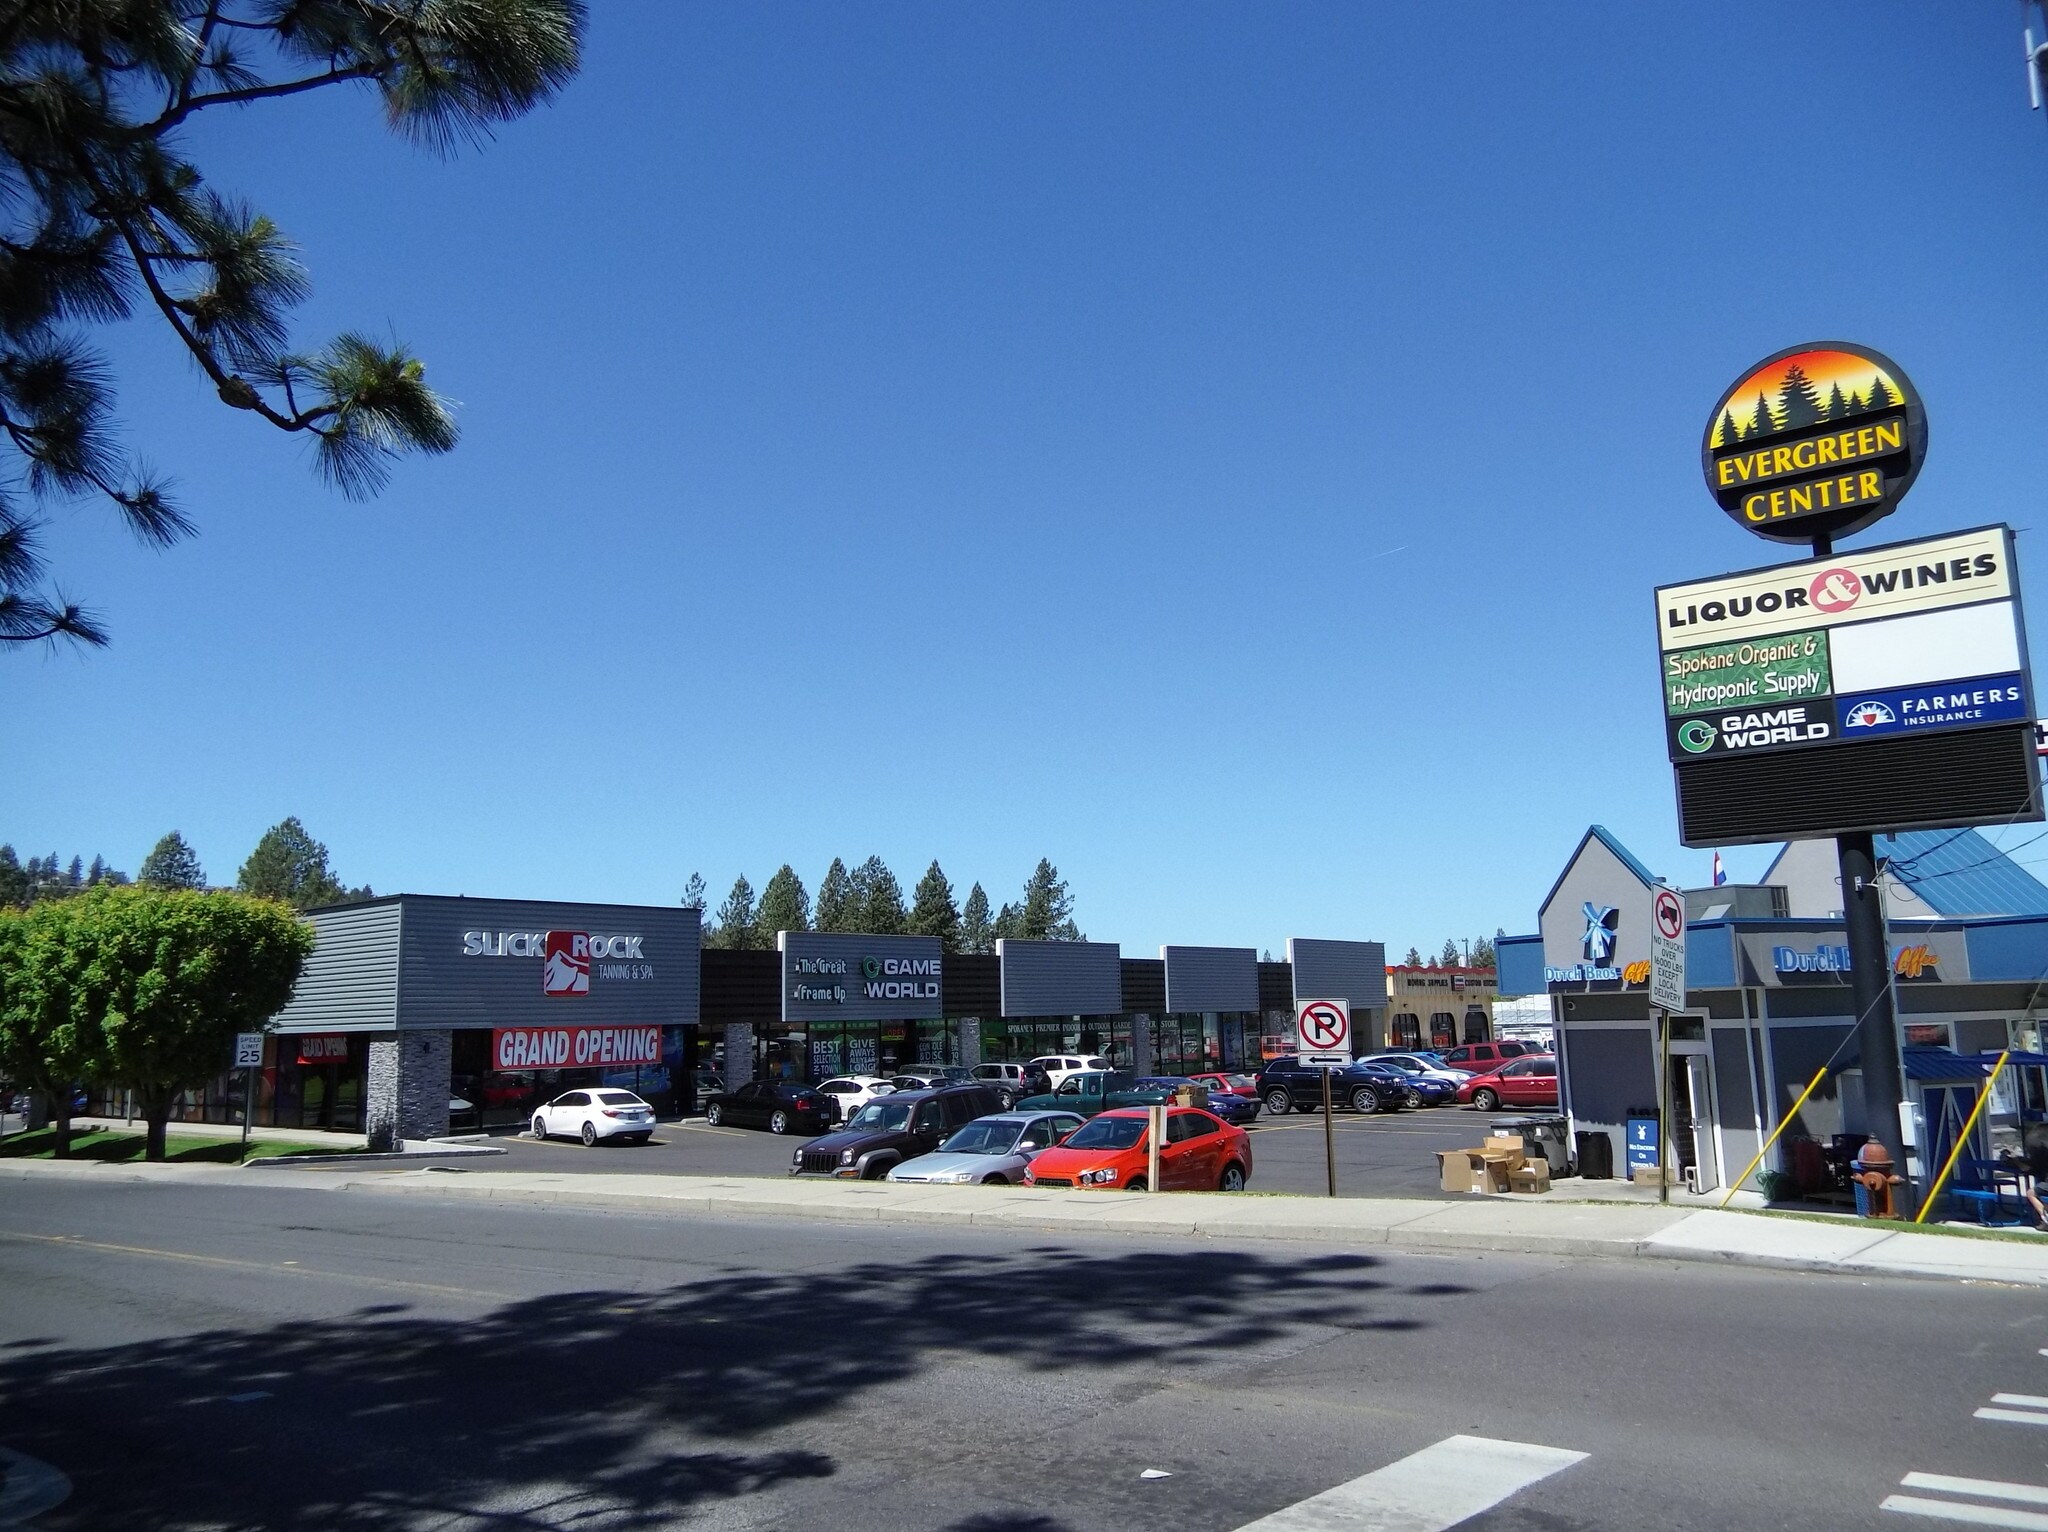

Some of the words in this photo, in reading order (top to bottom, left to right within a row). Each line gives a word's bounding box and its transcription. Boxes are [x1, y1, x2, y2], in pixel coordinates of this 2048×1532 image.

[1718, 422, 1901, 486] EVERGREEN
[1745, 472, 1880, 522] CENTER
[1668, 587, 1808, 628] LIQUOR
[1816, 572, 1860, 607] &
[1861, 553, 1996, 595] WINES
[1668, 652, 1734, 679] Spokane
[1738, 641, 1799, 668] Organic
[1804, 636, 1817, 656] &
[1672, 678, 1759, 709] Hydroponic
[1764, 668, 1820, 696] Supply
[1901, 686, 2019, 714] FARMERS
[1722, 707, 1807, 732] GAME
[1904, 709, 1982, 726] INSURANCE
[1722, 723, 1829, 749] WORLD
[463, 931, 546, 957] SLICK
[572, 934, 644, 959] ROCK
[1653, 935, 1661, 946] NO
[1663, 938, 1684, 954] TRUCKS
[1661, 948, 1677, 960] OVER
[1894, 944, 1938, 978] Coffee
[598, 964, 630, 979] TANNING
[632, 965, 638, 979] &
[640, 965, 653, 979] SPA
[800, 958, 816, 974] The
[818, 958, 847, 974] Great
[884, 959, 941, 975] GAME
[1623, 960, 1650, 984] Coff
[1657, 967, 1679, 979] EXCEPT
[1672, 963, 1683, 974] LBS
[800, 984, 832, 1000] Frame
[834, 985, 846, 1003] Up
[866, 982, 938, 998] WORLD
[1658, 979, 1678, 992] LOCAL
[1654, 986, 1681, 1004] DELIVERY
[1036, 1023, 1060, 1032] PREMIER
[1063, 1023, 1081, 1032] INDOOR
[1088, 1022, 1110, 1031] OUTDOOR
[1113, 1021, 1132, 1029] GARDE
[1161, 1020, 1178, 1028] STORE
[500, 1030, 570, 1067] GRAND
[575, 1028, 658, 1063] OPENING
[813, 1041, 840, 1054] BEST
[850, 1039, 875, 1049] GIVE
[239, 1050, 260, 1063] 25
[813, 1054, 840, 1064] SELECTION
[850, 1049, 875, 1057] AWAYS
